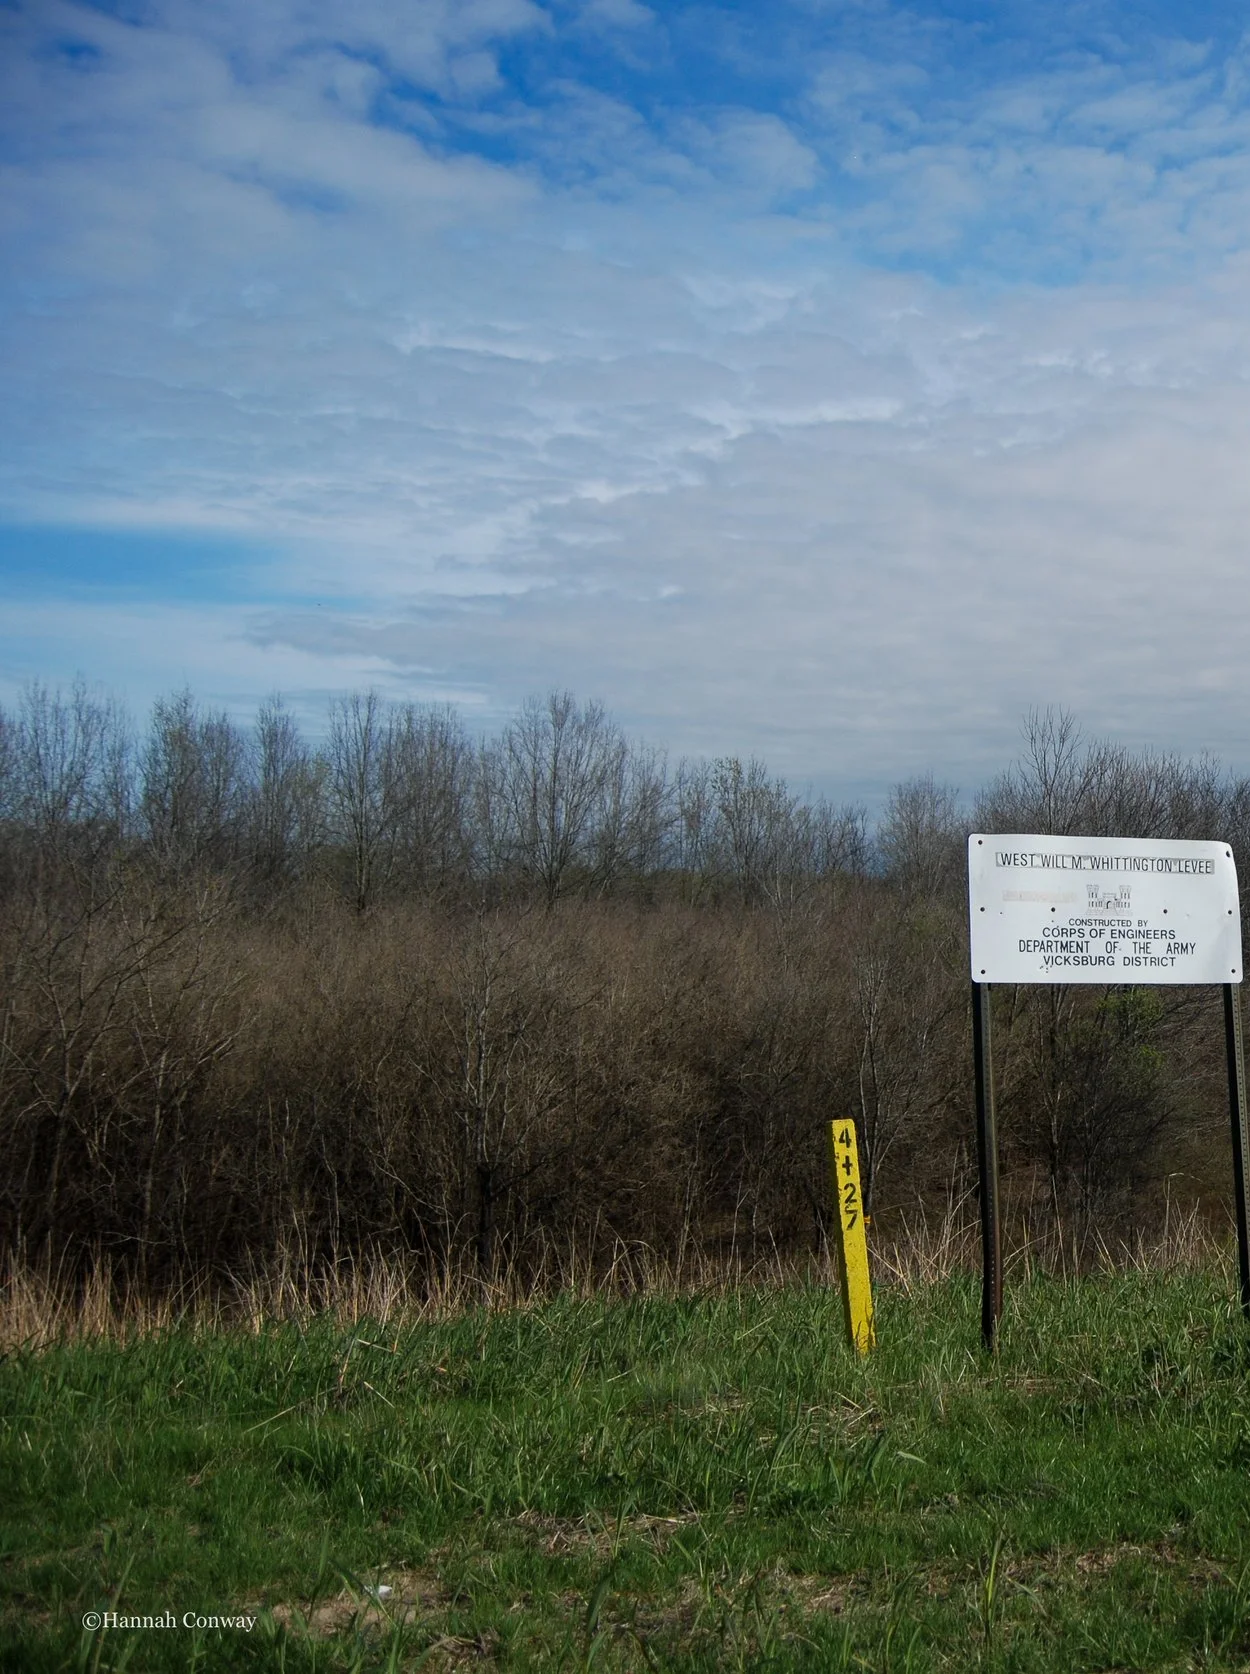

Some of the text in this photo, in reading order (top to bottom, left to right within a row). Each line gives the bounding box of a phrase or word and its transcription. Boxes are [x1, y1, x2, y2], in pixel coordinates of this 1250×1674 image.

[1000, 853, 1212, 874] WEST WILL M. WHITTINGTON LEVEE
[1068, 918, 1149, 927] CONSTRUCTED BY
[1042, 927, 1176, 940] CORPS OF ENGINEERS
[1019, 940, 1197, 955] DEPARTMENT OF THE ARMY
[1043, 955, 1176, 967] VICKSBURG DISTRICT
